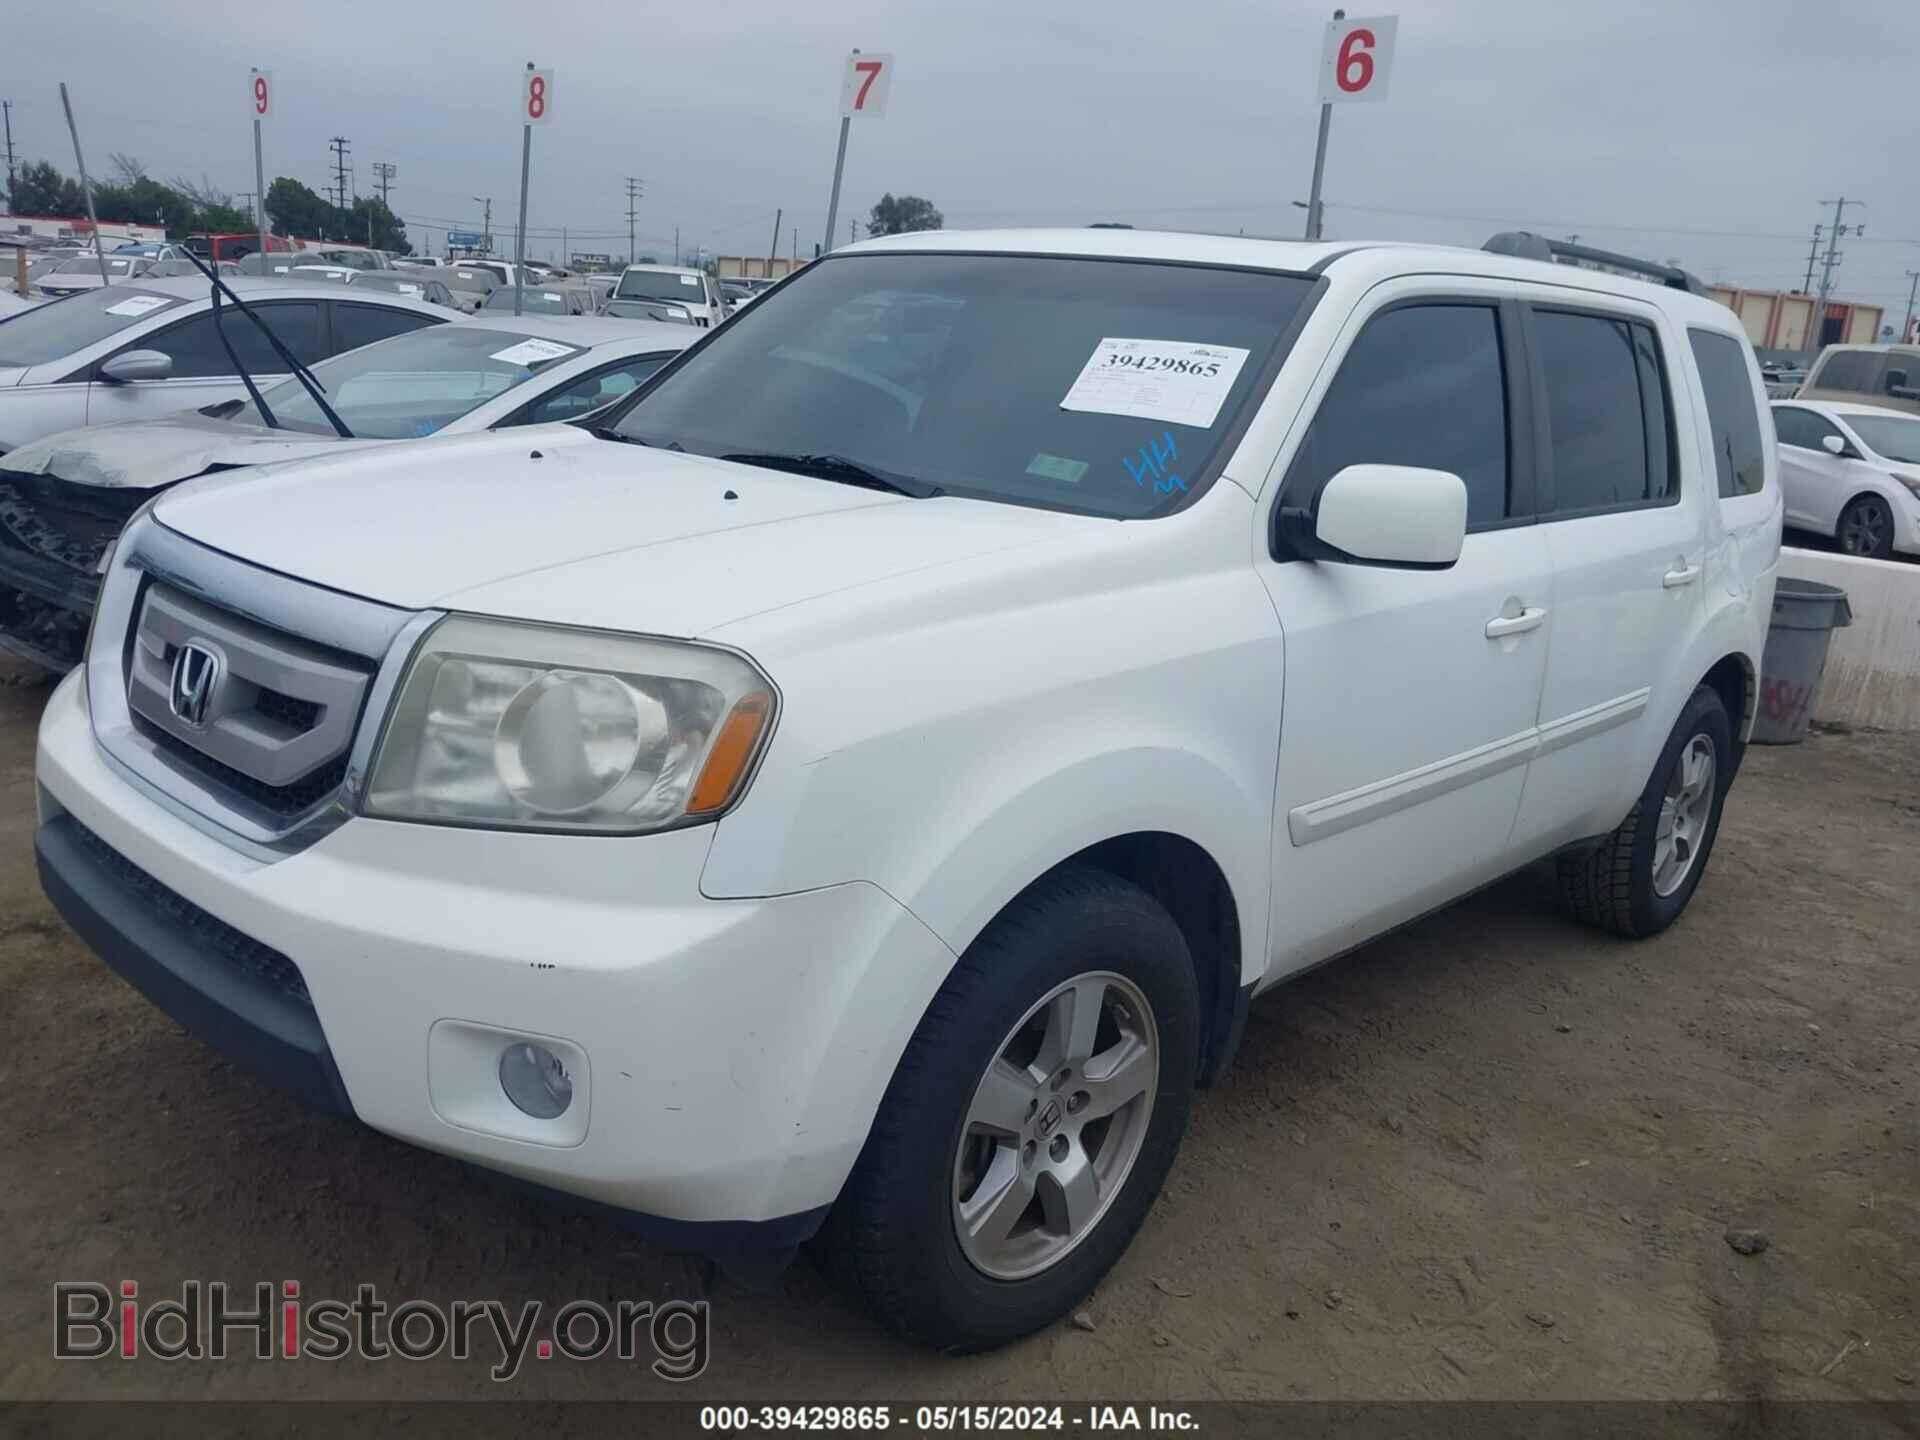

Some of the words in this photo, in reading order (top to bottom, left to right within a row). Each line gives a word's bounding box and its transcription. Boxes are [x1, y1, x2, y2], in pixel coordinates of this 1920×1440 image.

[1335, 29, 1376, 93] 6
[255, 77, 268, 114] 9
[528, 76, 545, 119] 8
[854, 62, 883, 110] 7
[1101, 354, 1222, 378] 39429865
